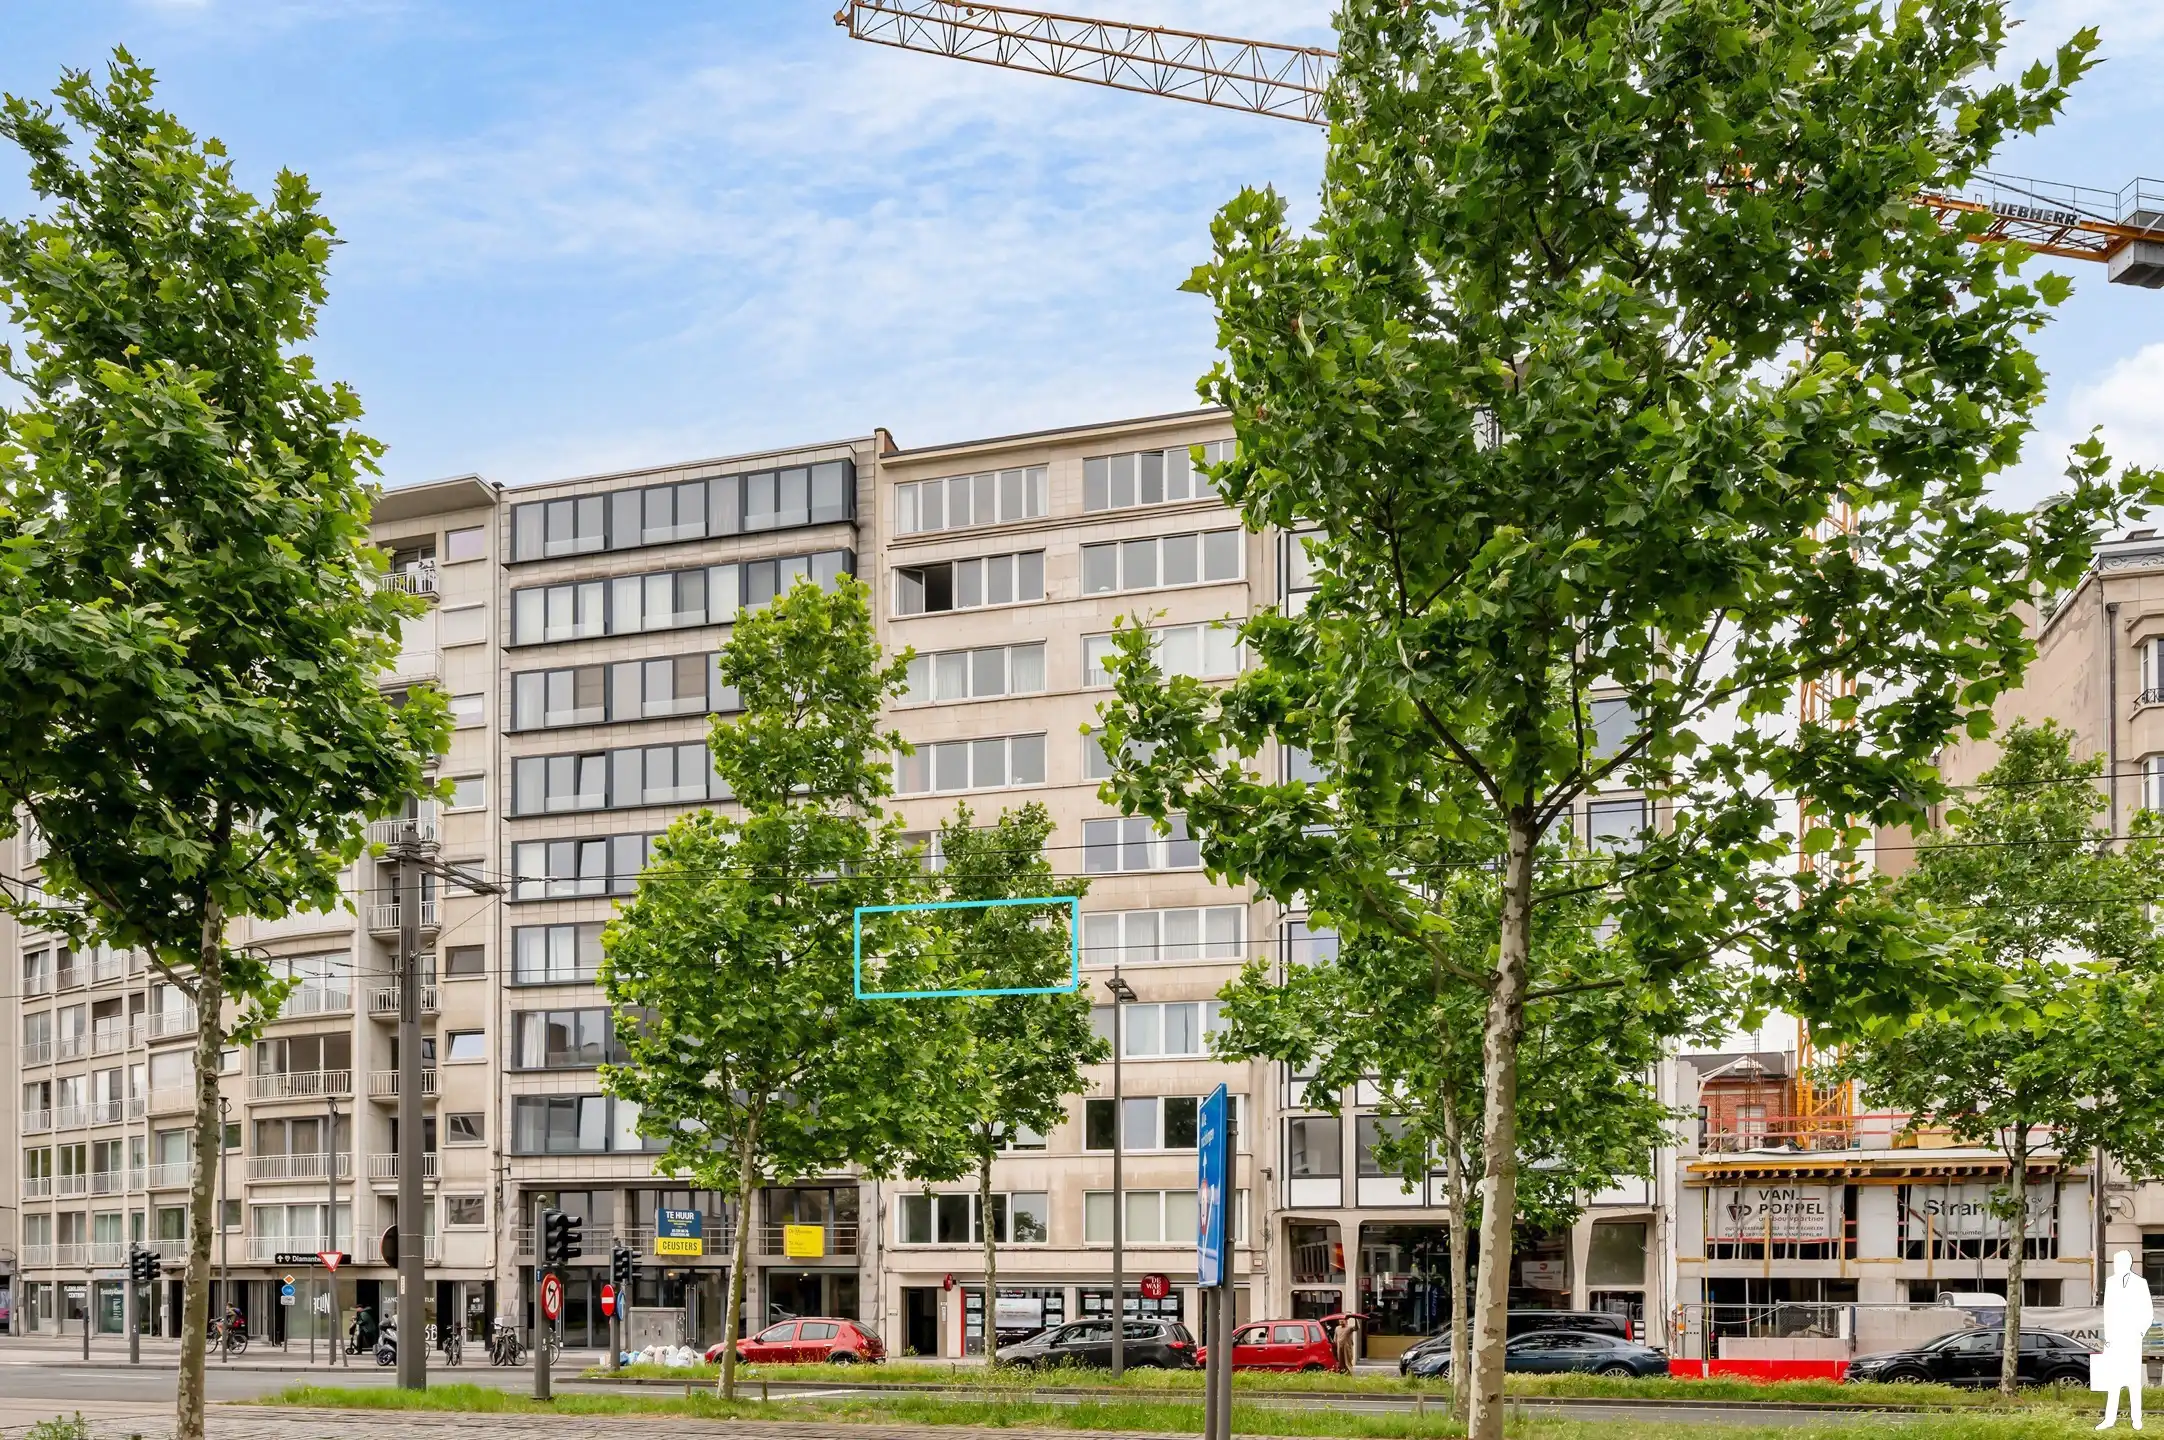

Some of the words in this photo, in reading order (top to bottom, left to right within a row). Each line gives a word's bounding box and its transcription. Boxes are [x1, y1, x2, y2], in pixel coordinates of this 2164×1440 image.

[1992, 201, 2079, 226] LIEBHERR
[1758, 1189, 1795, 1201] VAN
[665, 1210, 675, 1219] TE
[675, 1211, 695, 1220] HUUR
[1759, 1203, 1825, 1215] POPPEL
